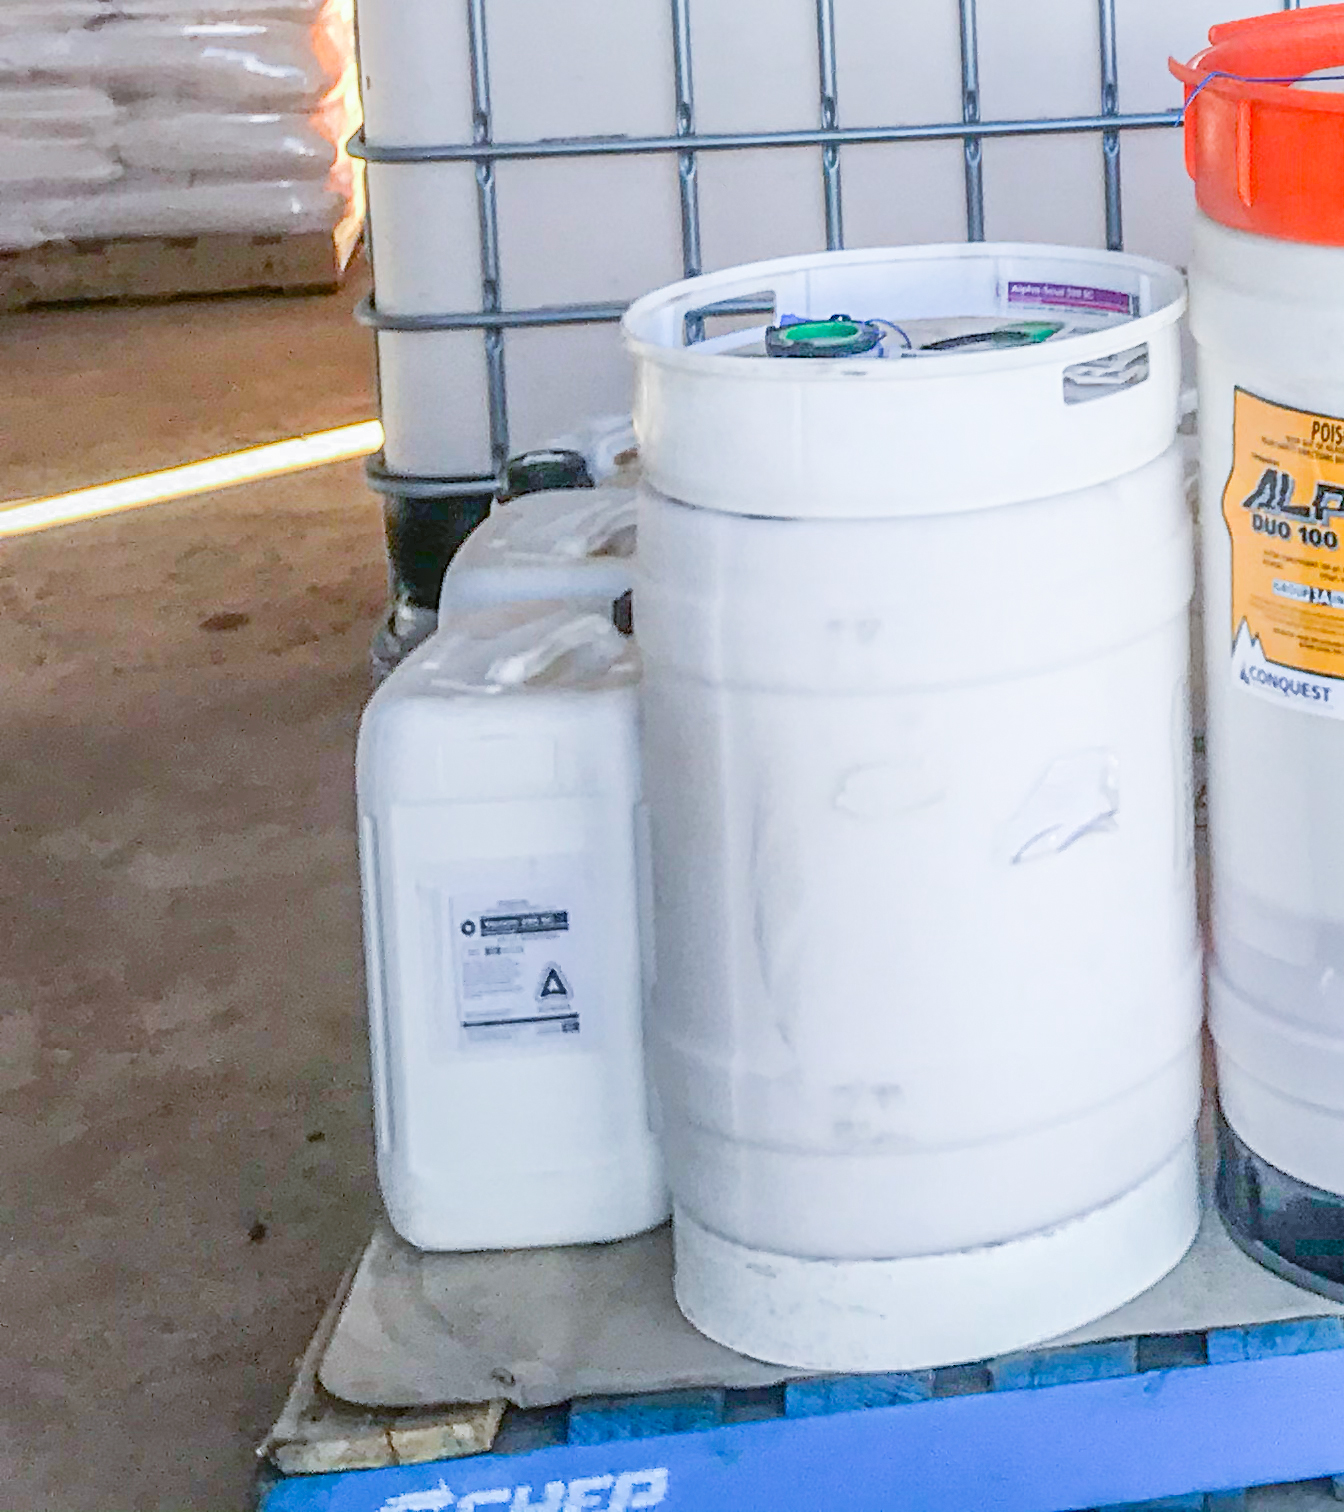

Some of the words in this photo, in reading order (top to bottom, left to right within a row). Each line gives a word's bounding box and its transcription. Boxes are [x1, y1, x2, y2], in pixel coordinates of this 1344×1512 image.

[1252, 513, 1291, 539] DUO
[1298, 524, 1339, 550] 100
[1250, 666, 1332, 703] CONQUEST
